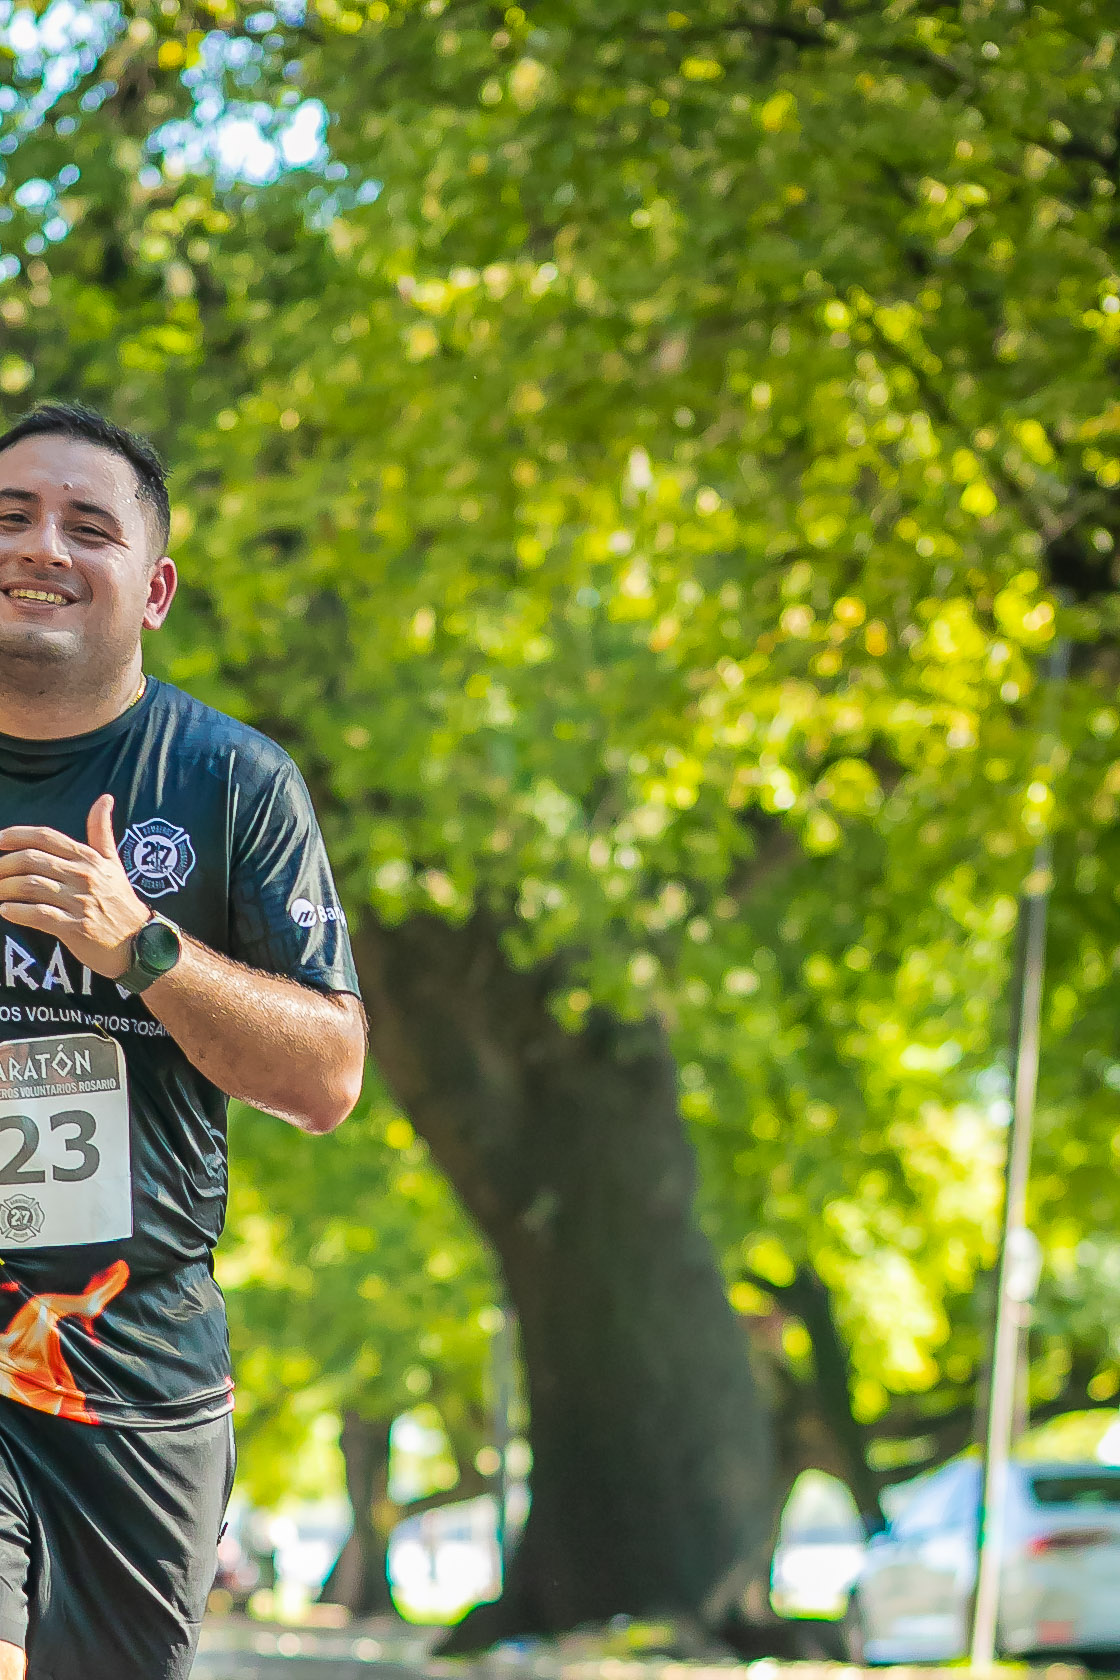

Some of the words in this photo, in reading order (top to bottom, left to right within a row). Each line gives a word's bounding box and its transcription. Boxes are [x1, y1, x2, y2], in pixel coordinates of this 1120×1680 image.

[140, 840, 173, 867] 27
[25, 1006, 130, 1032] VOLUNRIOS
[19, 1081, 78, 1098] VOLUNTARIOS
[78, 1077, 117, 1093] ROSARIO
[10, 1208, 31, 1226] 27
